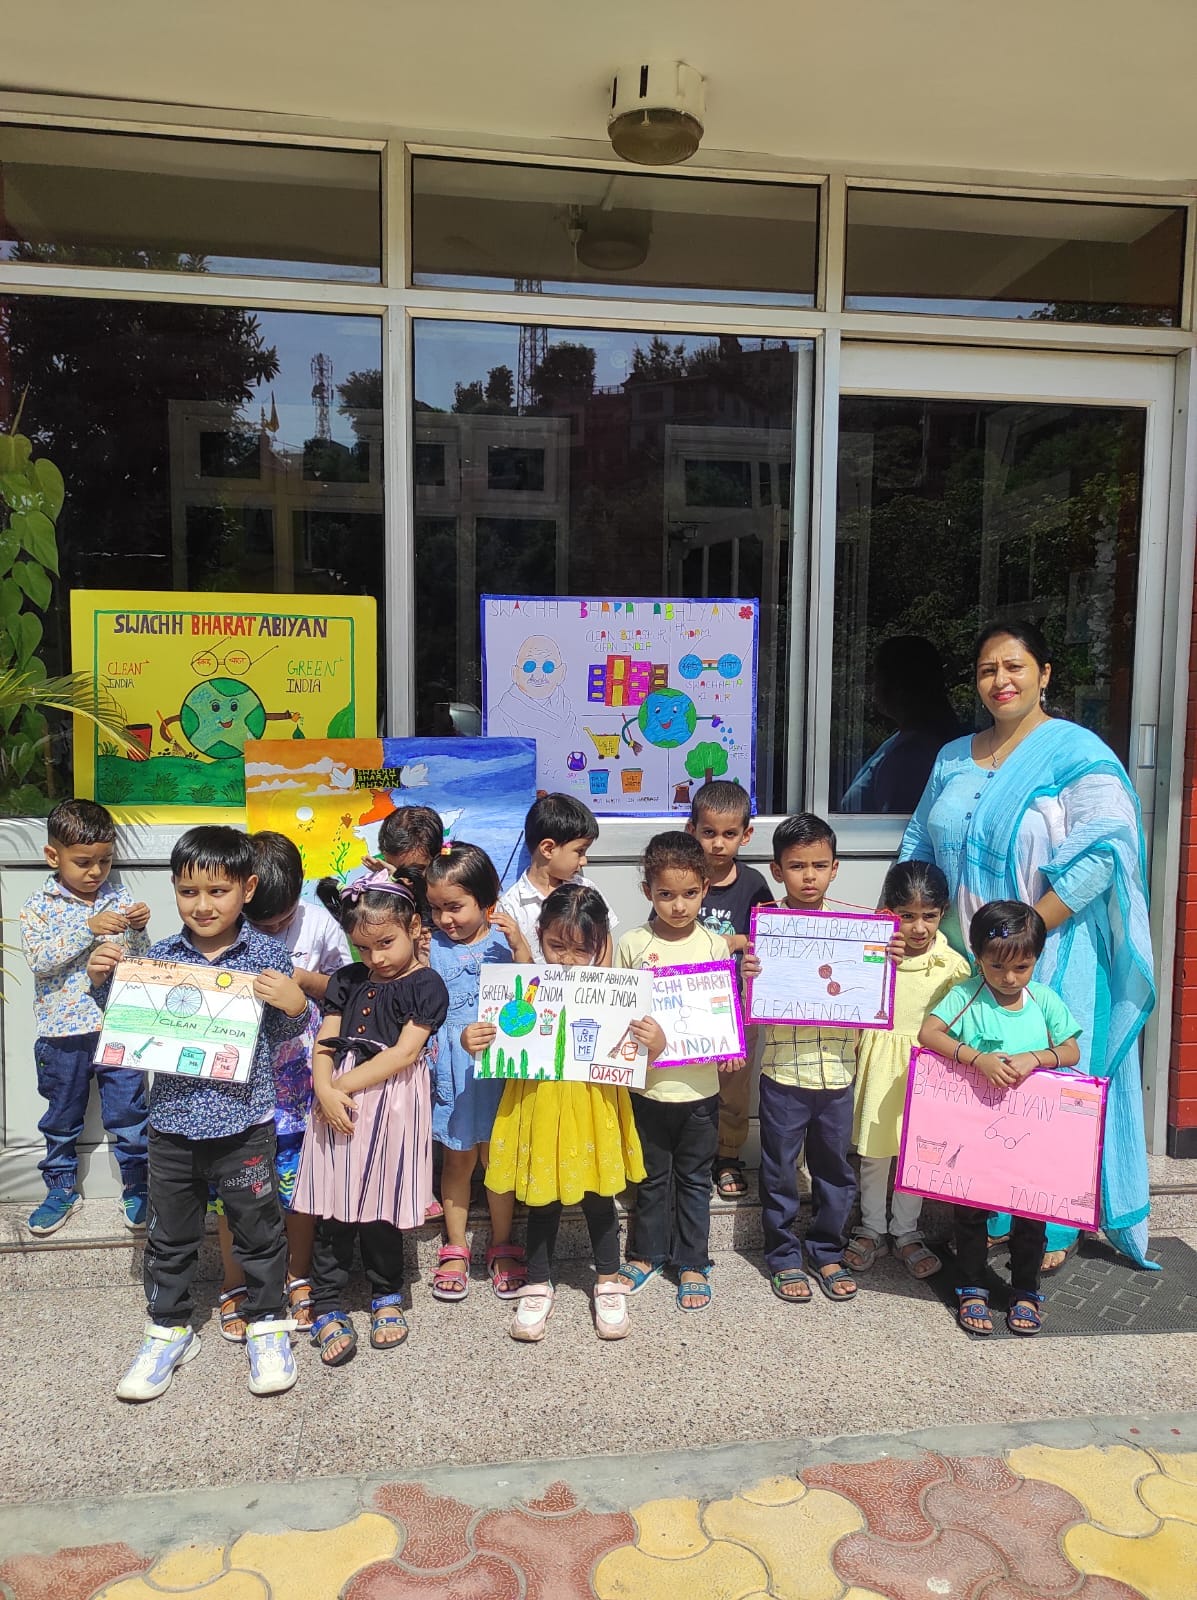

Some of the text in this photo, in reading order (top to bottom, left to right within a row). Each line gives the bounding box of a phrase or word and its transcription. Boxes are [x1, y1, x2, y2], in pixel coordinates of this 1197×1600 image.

[489, 600, 736, 622] SWACHH BHARAT ABHIYAN
[114, 614, 328, 638] SWACHH BHARAT ABIYAN
[585, 629, 615, 643] CLEAN
[108, 661, 142, 676] CLEAN
[287, 660, 337, 677] GREEN
[108, 678, 135, 689] INDIA
[286, 678, 321, 693] INDIA
[756, 938, 835, 960] ABHIYAN
[543, 970, 639, 987] SWACHH BHARAT ABHIYAN
[652, 974, 731, 994] ACHH BHARAT
[481, 984, 638, 1008] GREEN INDIA CLEAN INDIA
[652, 995, 684, 1012] IYAN
[159, 1018, 246, 1039] CLEAN INDIA
[576, 1033, 595, 1044] USE
[681, 1036, 730, 1057] INDIA
[577, 1045, 592, 1056] ME
[591, 1066, 631, 1085] OJASVI
[912, 1073, 979, 1105] BHARAT
[905, 1165, 1070, 1219] CLEAN INDIA
